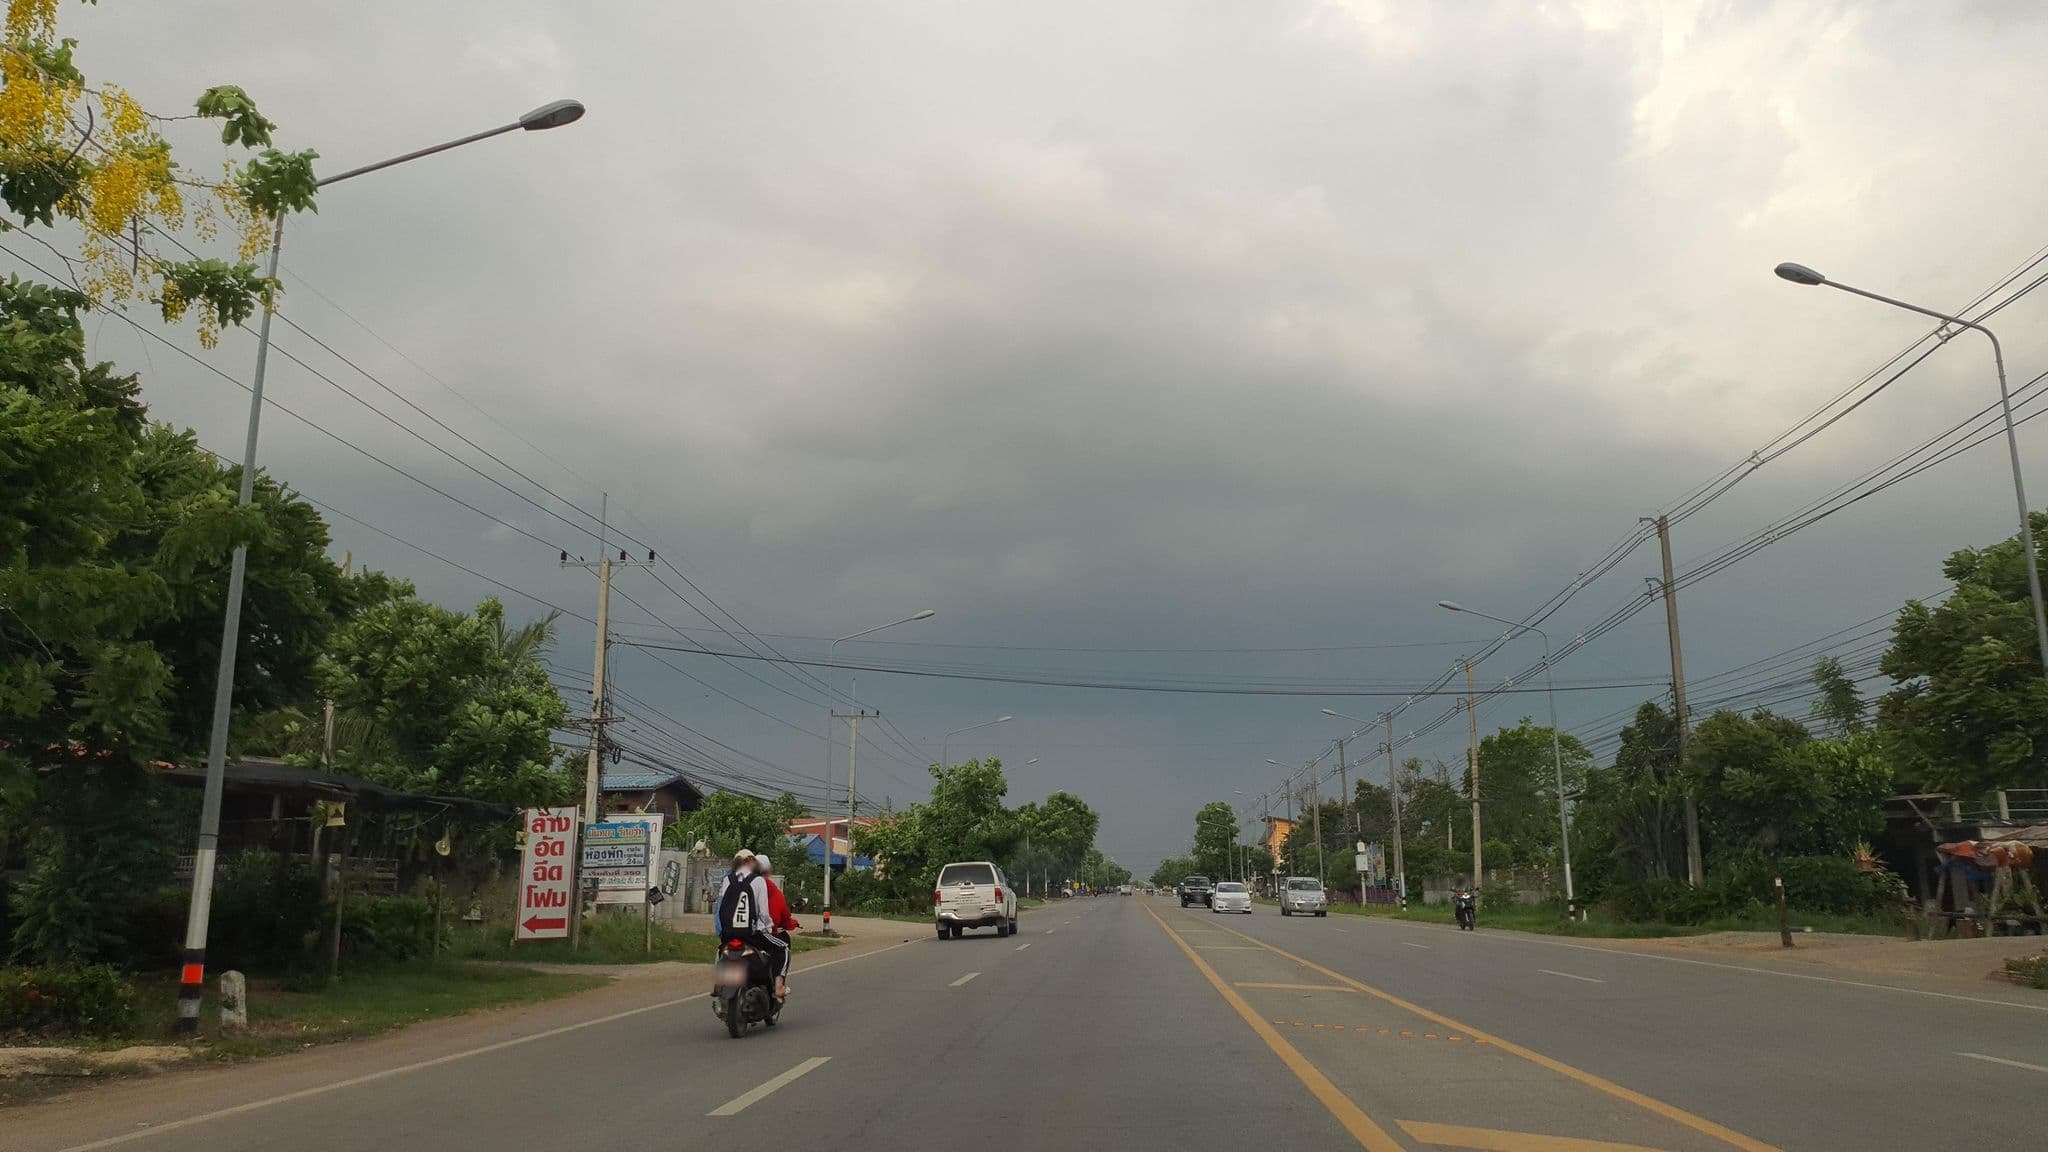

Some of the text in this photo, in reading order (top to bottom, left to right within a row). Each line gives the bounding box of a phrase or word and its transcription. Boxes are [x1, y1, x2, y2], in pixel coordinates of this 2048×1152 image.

[531, 811, 571, 834] ล้าง
[534, 835, 565, 857] อัด
[533, 860, 563, 882] ฉีด
[526, 884, 567, 908] โฟม
[736, 894, 747, 923] FILA
